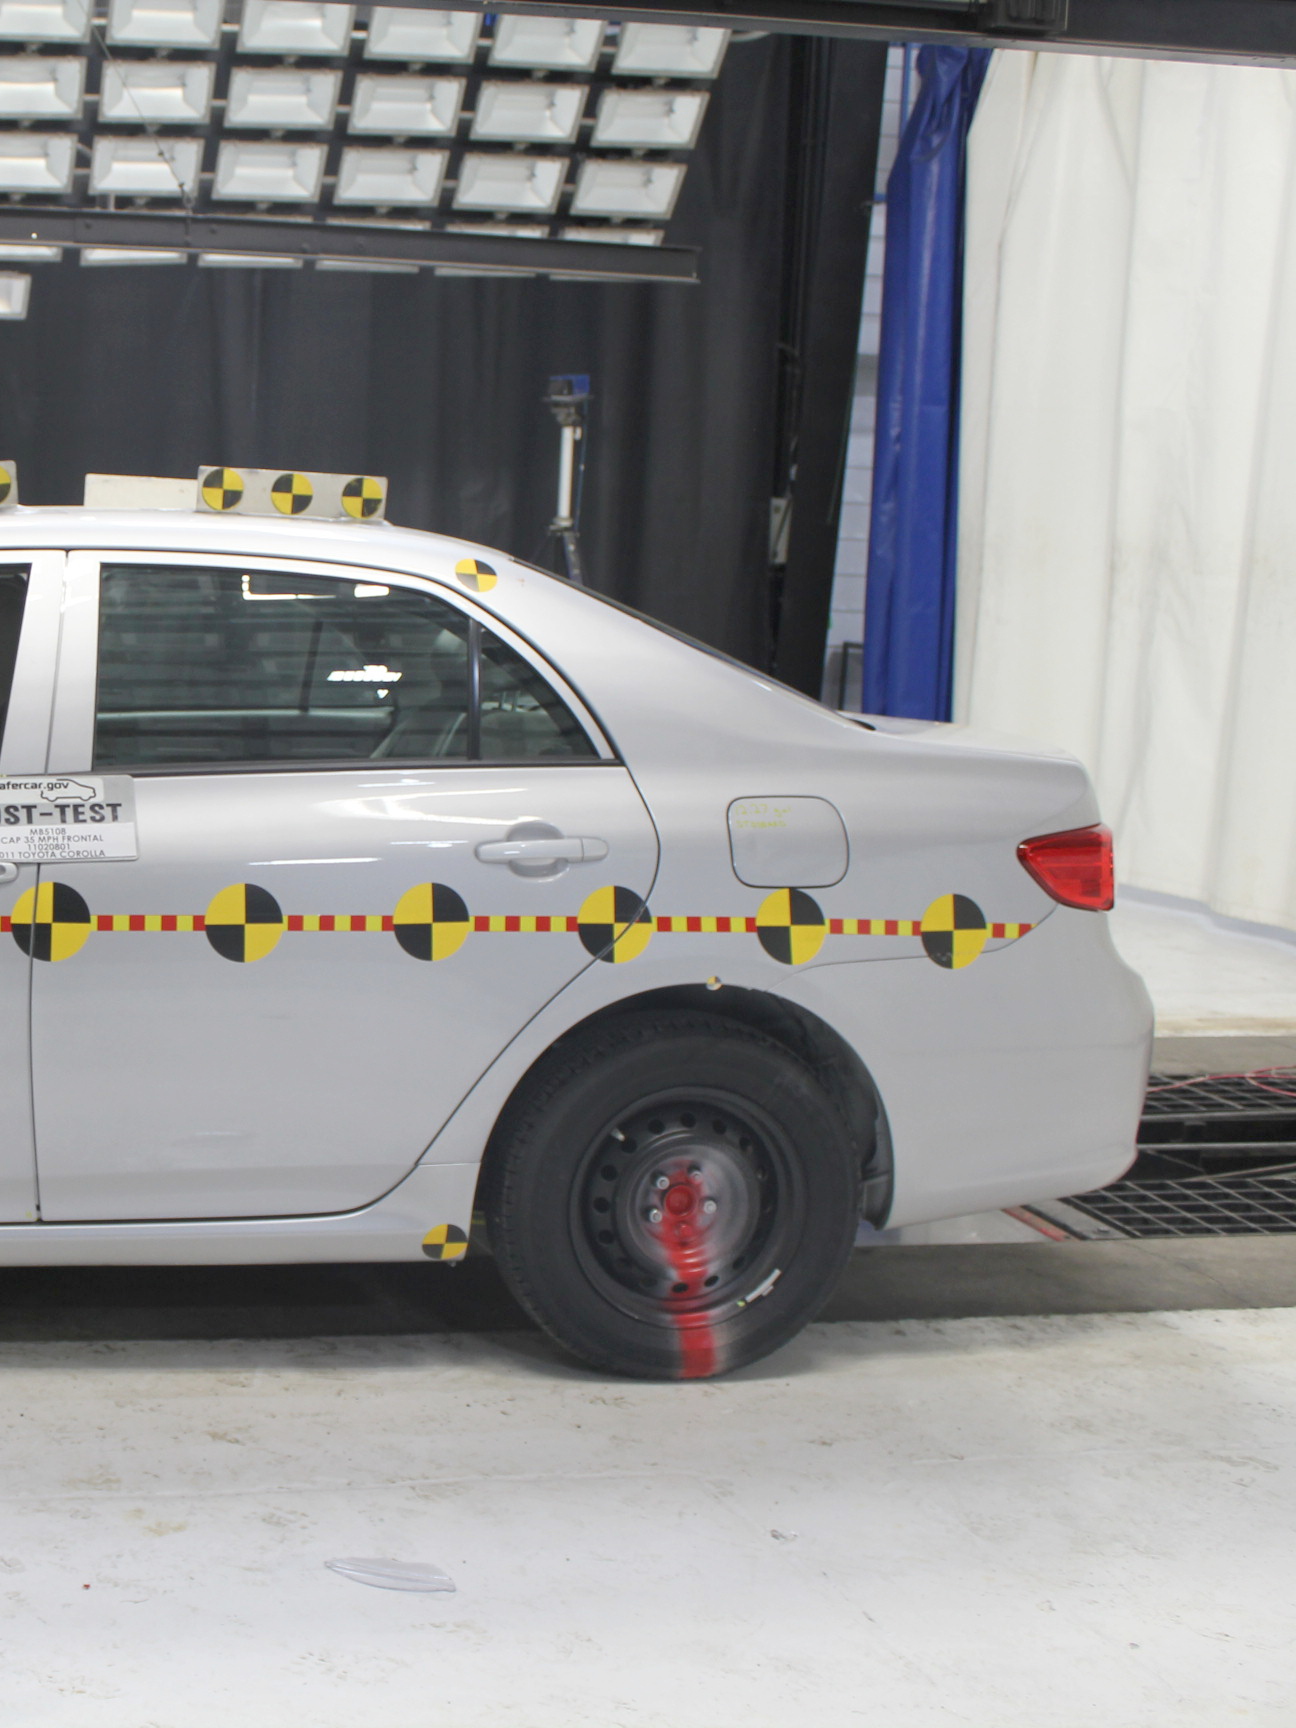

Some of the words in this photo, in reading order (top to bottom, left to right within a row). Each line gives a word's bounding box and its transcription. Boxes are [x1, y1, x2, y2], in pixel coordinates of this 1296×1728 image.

[24, 836, 35, 844] 35
[62, 834, 104, 842] FRONTAL
[28, 843, 70, 851] 11020801
[18, 850, 57, 859] TOYOTA
[60, 850, 106, 858] COROLLA
